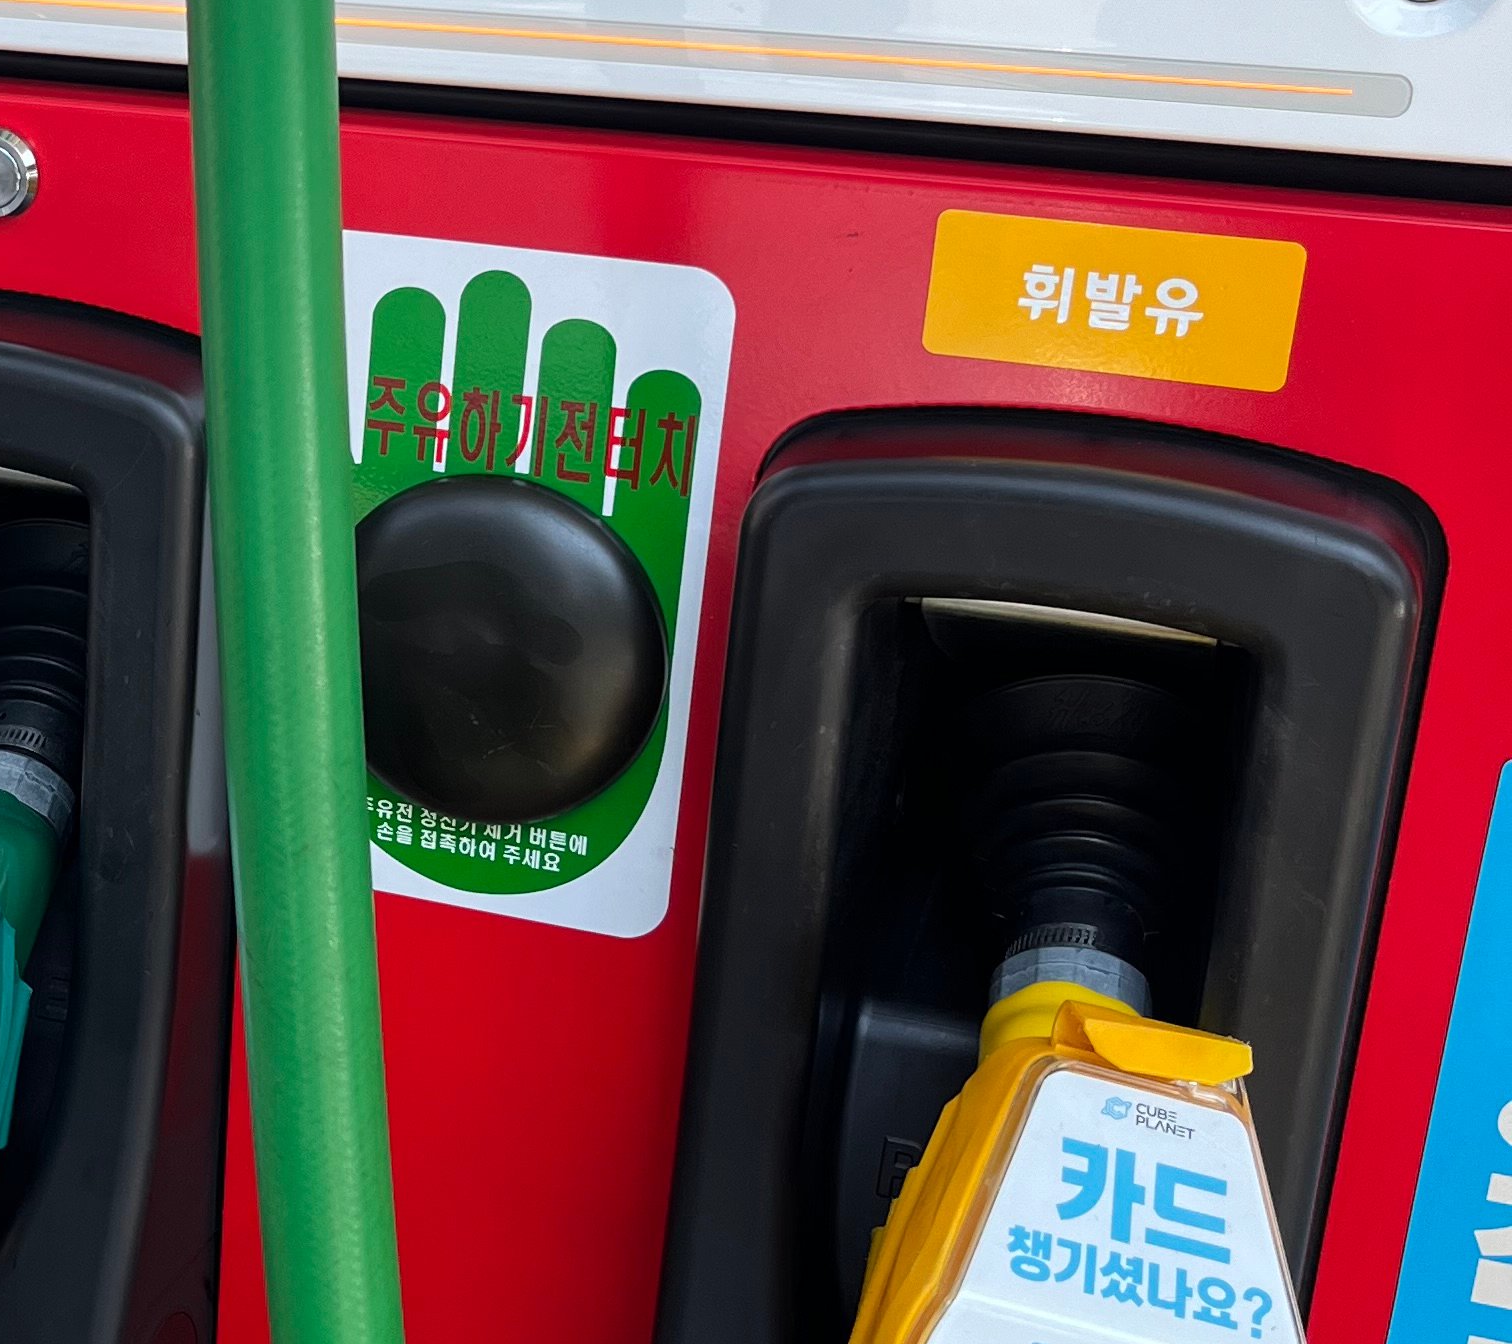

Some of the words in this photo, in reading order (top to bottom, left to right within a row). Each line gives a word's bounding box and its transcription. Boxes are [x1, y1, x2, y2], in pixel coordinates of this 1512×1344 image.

[1016, 263, 1205, 338] 휘발유
[366, 375, 696, 498] 주유하기전터치
[376, 821, 413, 846] 손을
[419, 829, 496, 862] 접촉하여
[502, 844, 561, 873] 주세요
[529, 826, 588, 856] 버튼에
[1135, 1102, 1178, 1124] CUBE
[1135, 1114, 1196, 1140] PLANET
[1055, 1135, 1231, 1265] 카드
[1006, 1223, 1274, 1341] 챙기셨나요?
